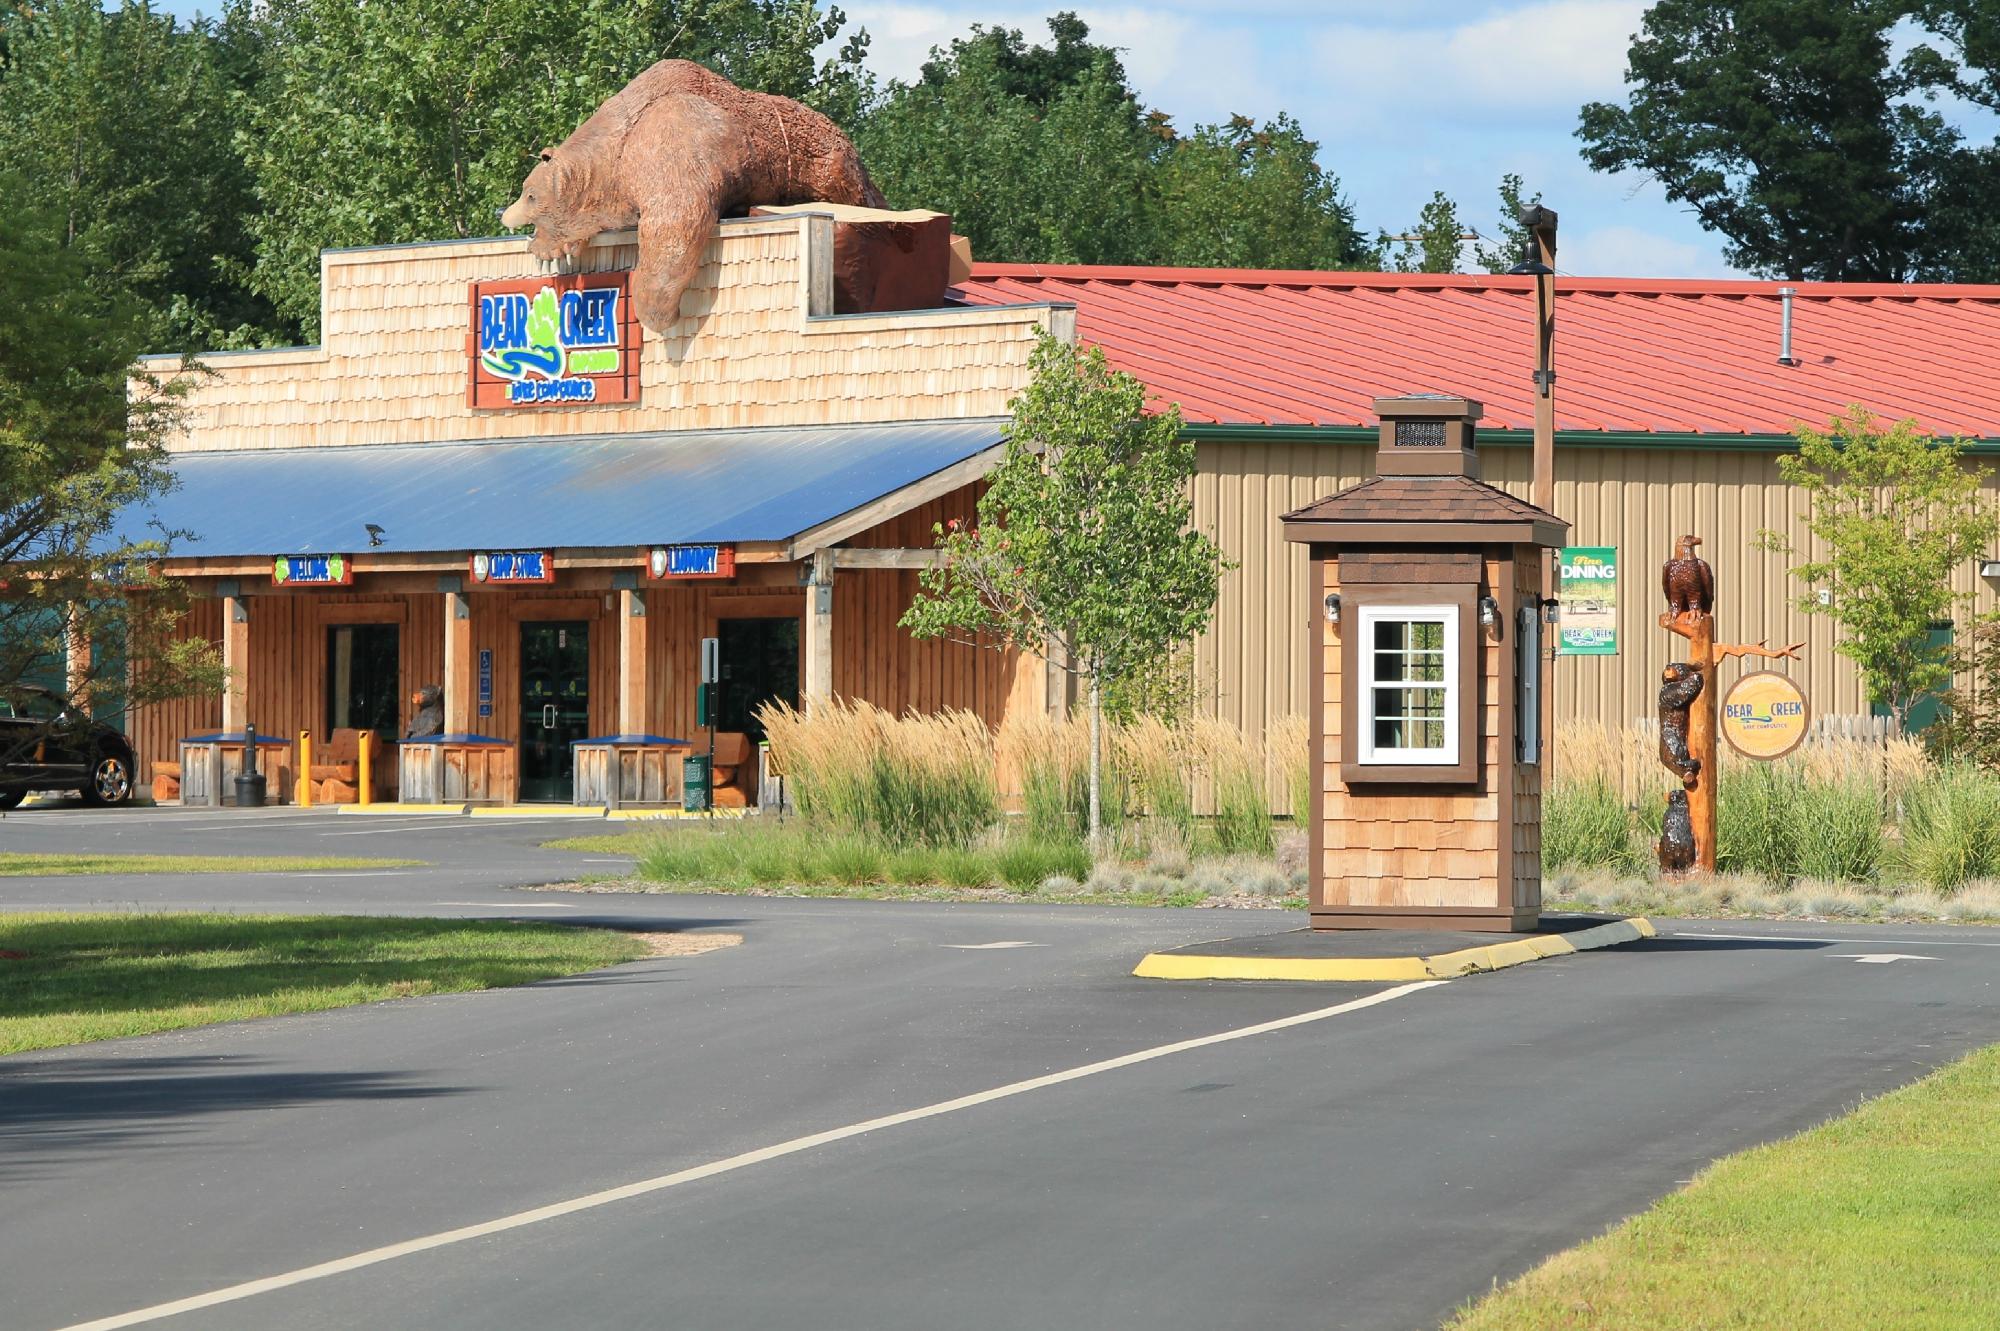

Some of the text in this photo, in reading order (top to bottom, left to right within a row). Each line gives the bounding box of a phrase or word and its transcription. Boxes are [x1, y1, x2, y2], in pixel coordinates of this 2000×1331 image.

[482, 289, 619, 350] BEAR CREEK
[1561, 565, 1616, 579] DINING
[1564, 629, 1614, 638] BEAR CREEK
[1726, 701, 1802, 717] BEAR CREEK
